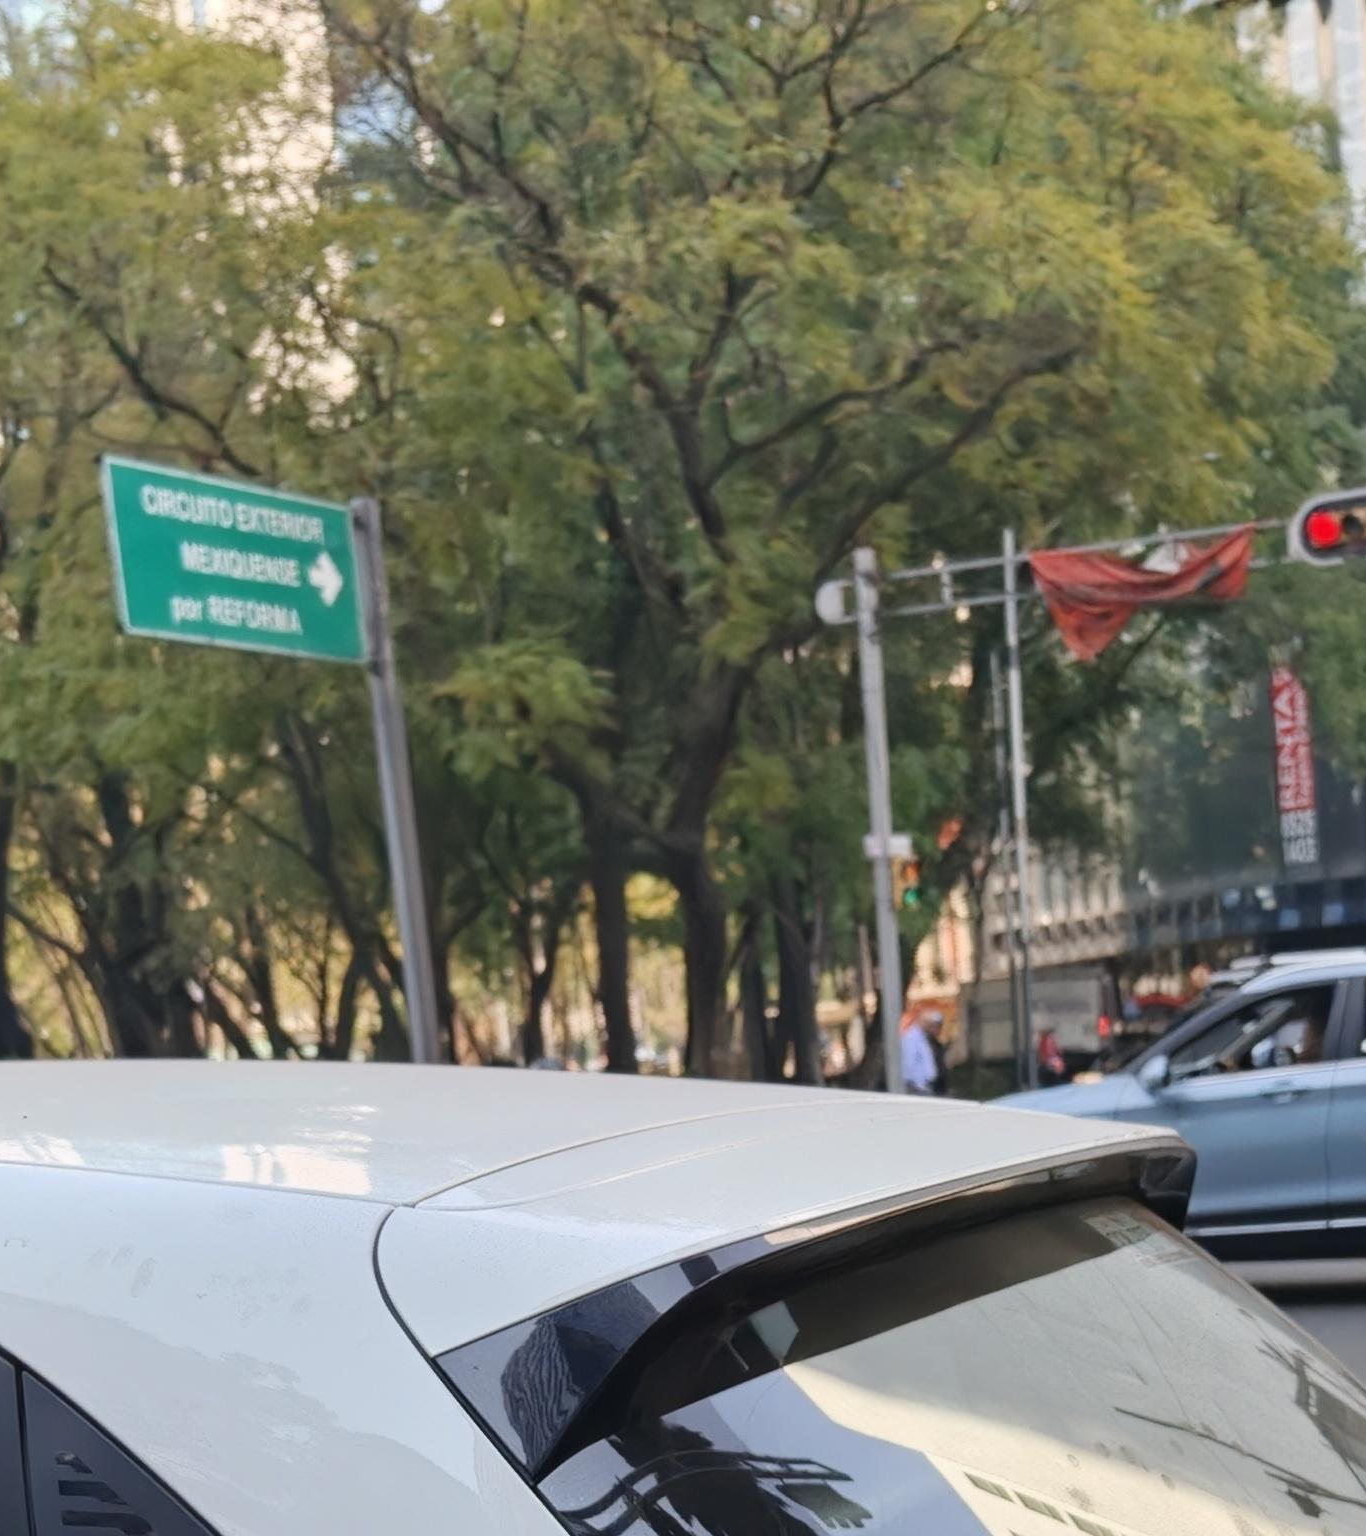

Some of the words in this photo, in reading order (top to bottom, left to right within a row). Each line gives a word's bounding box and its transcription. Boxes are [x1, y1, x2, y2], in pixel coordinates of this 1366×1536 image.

[140, 483, 234, 529] CIRCUITO
[235, 502, 326, 544] EXTERIOR
[180, 540, 302, 588] MEXIQUENSE
[170, 596, 203, 624] por
[206, 595, 304, 635] REFORMA
